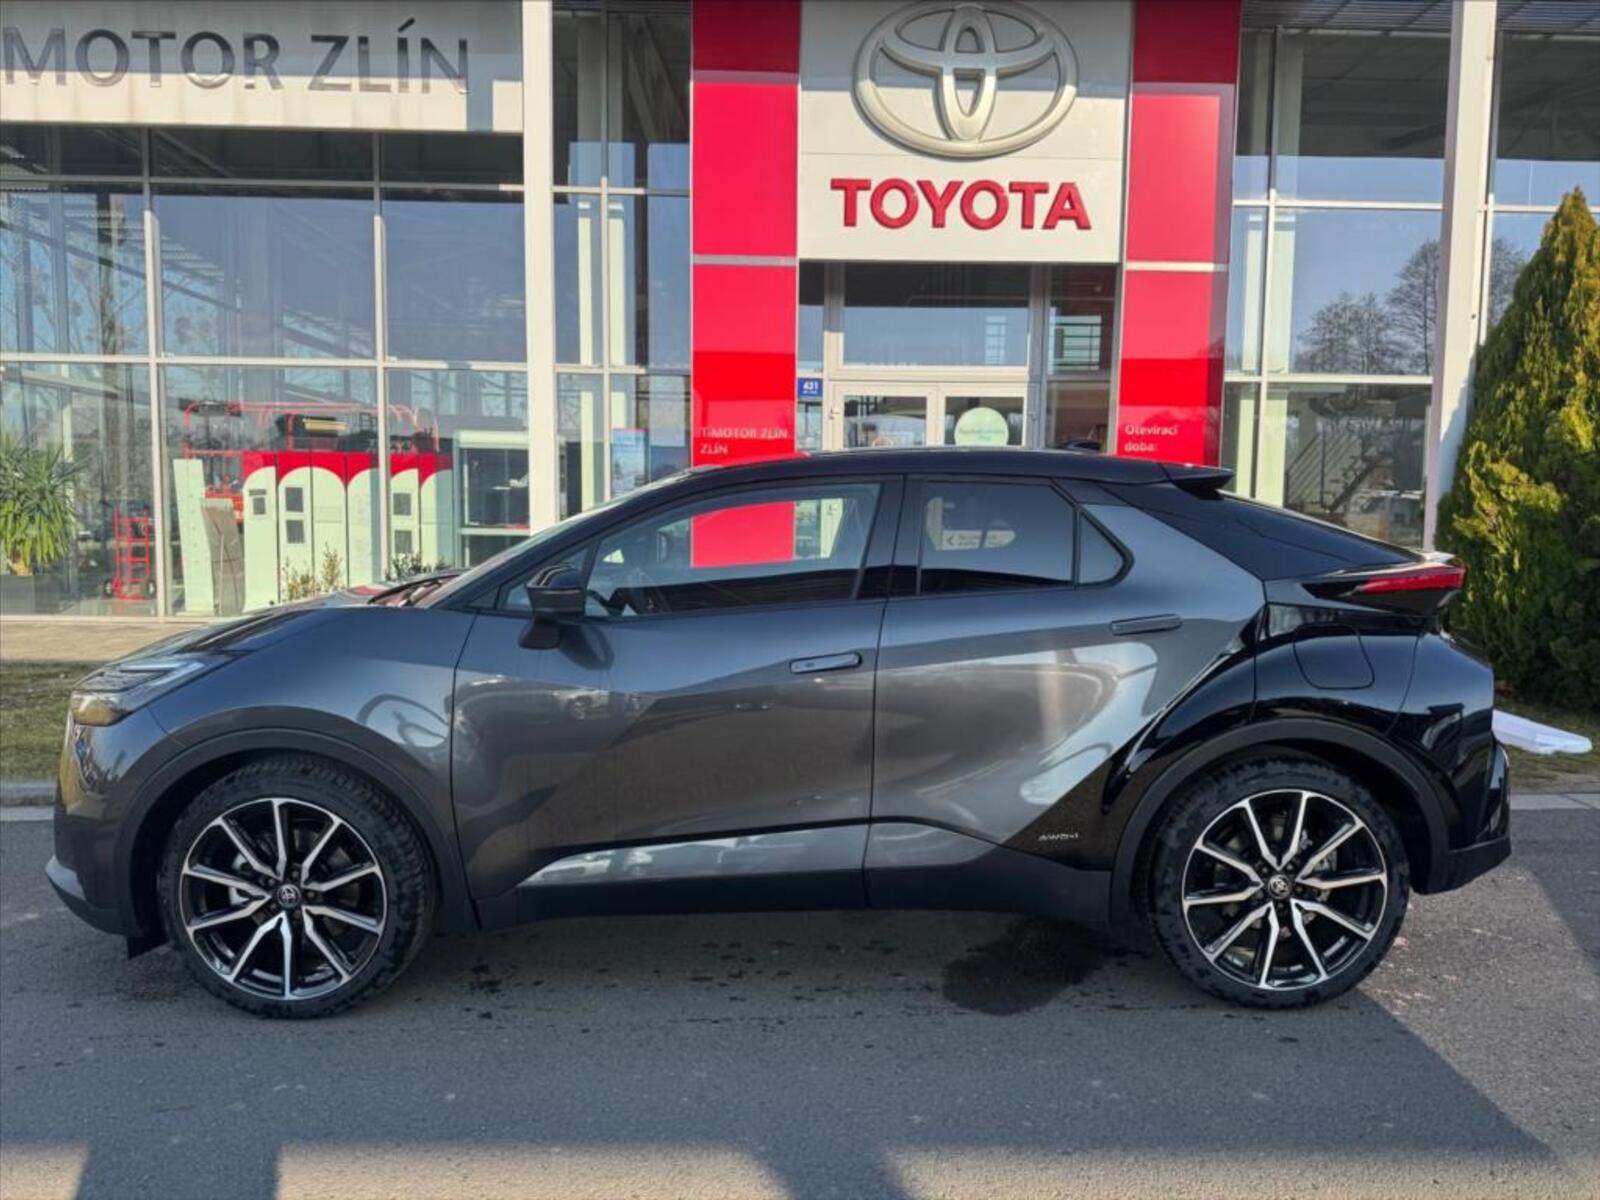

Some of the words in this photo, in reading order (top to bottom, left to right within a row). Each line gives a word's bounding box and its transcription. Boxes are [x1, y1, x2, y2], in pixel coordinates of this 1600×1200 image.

[2, 26, 283, 90] MOTOR
[308, 18, 469, 95] ZLÍN
[830, 178, 1092, 231] TOYOTA
[700, 441, 728, 454] ZLÍN
